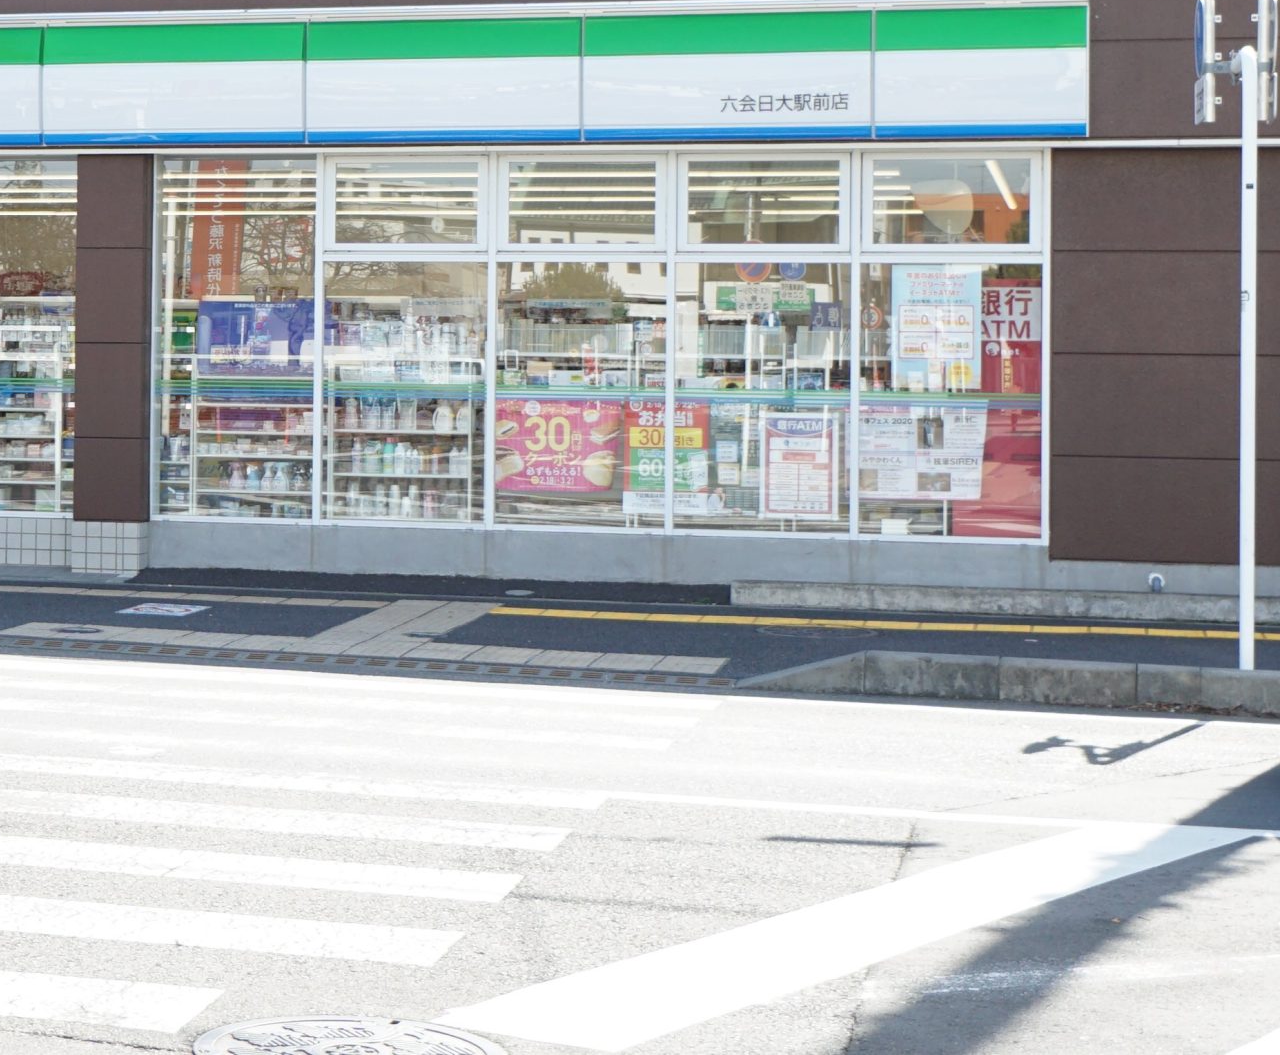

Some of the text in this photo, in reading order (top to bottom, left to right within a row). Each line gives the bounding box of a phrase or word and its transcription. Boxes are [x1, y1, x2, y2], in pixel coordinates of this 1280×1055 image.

[720, 94, 849, 112] 六会日大駅前店
[981, 289, 1032, 316] 銀行
[981, 320, 1031, 339] ATM
[639, 428, 695, 445] 30引き
